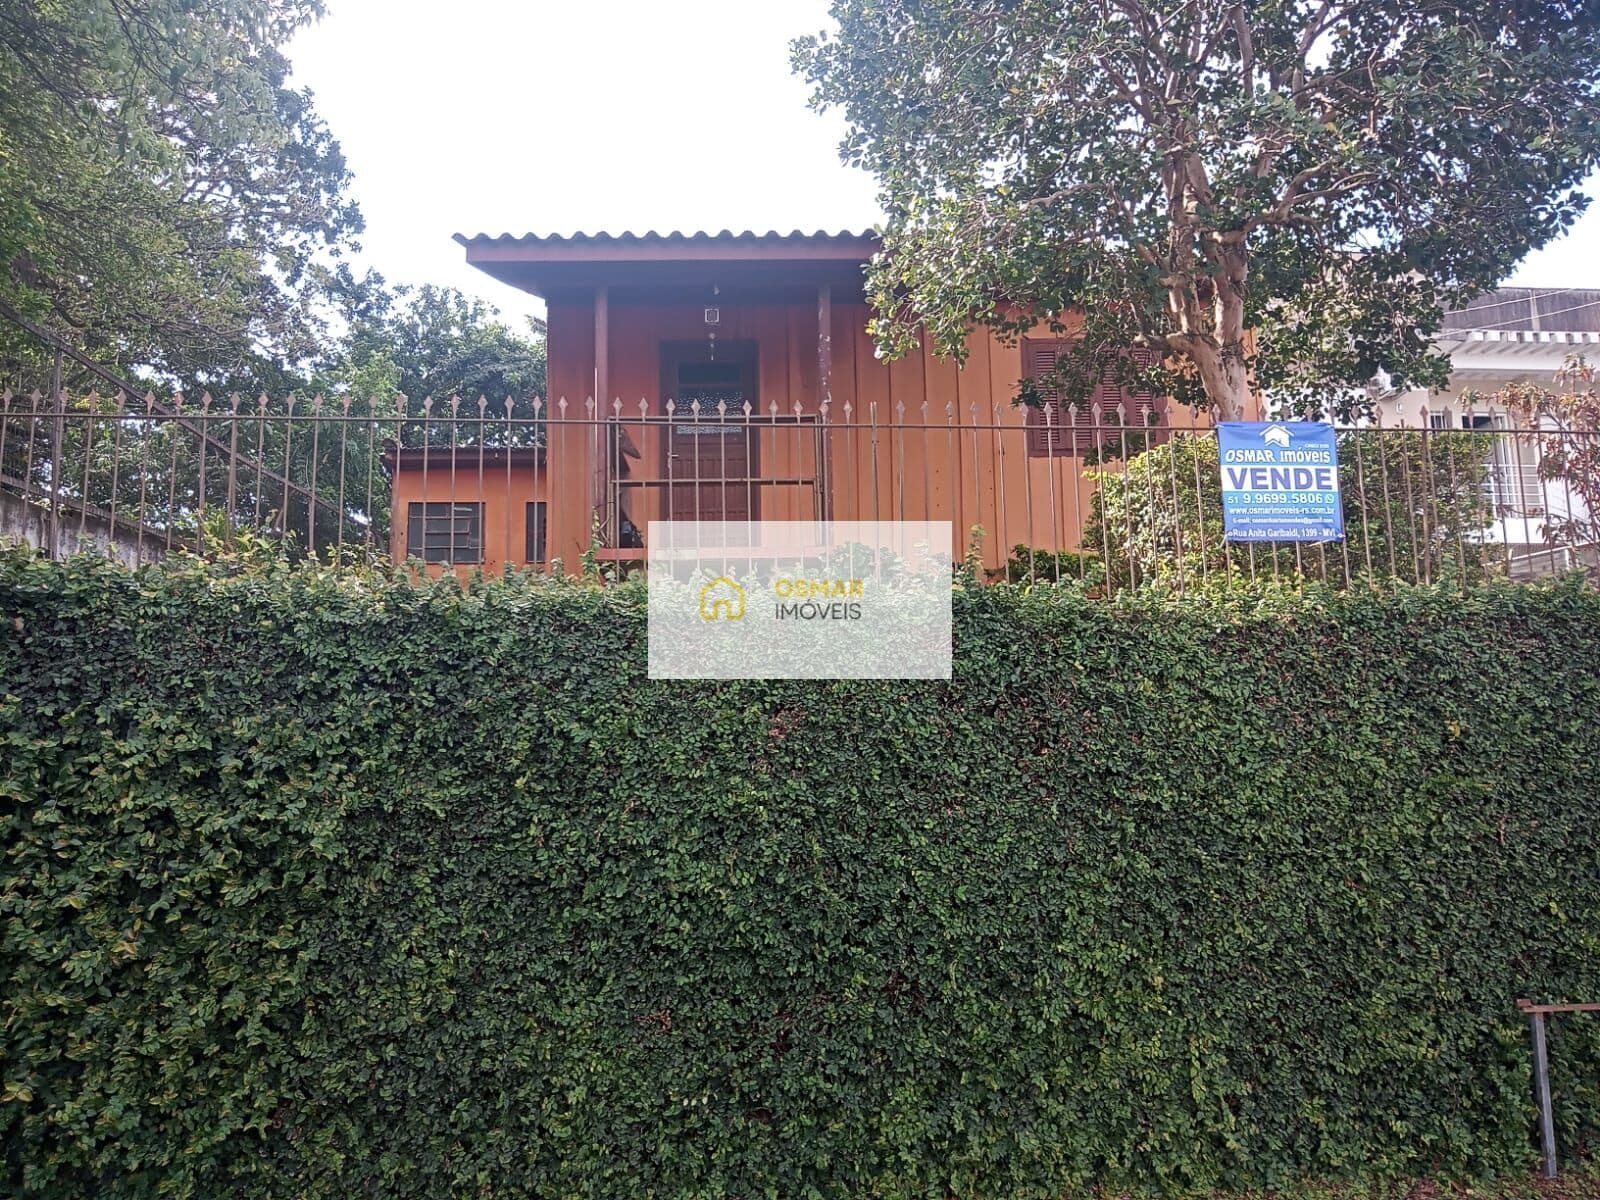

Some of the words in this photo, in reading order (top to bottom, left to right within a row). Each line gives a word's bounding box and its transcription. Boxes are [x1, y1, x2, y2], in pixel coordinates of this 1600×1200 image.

[1226, 449, 1276, 463] OSMAR
[1227, 467, 1333, 490] VENDE
[1228, 496, 1239, 504] 51
[1243, 493, 1323, 504] 9.9699.5806
[1229, 506, 1335, 515] www.osmarimoveis-rs.com.br
[1233, 529, 1247, 537] Rua
[1248, 528, 1266, 537] Anita
